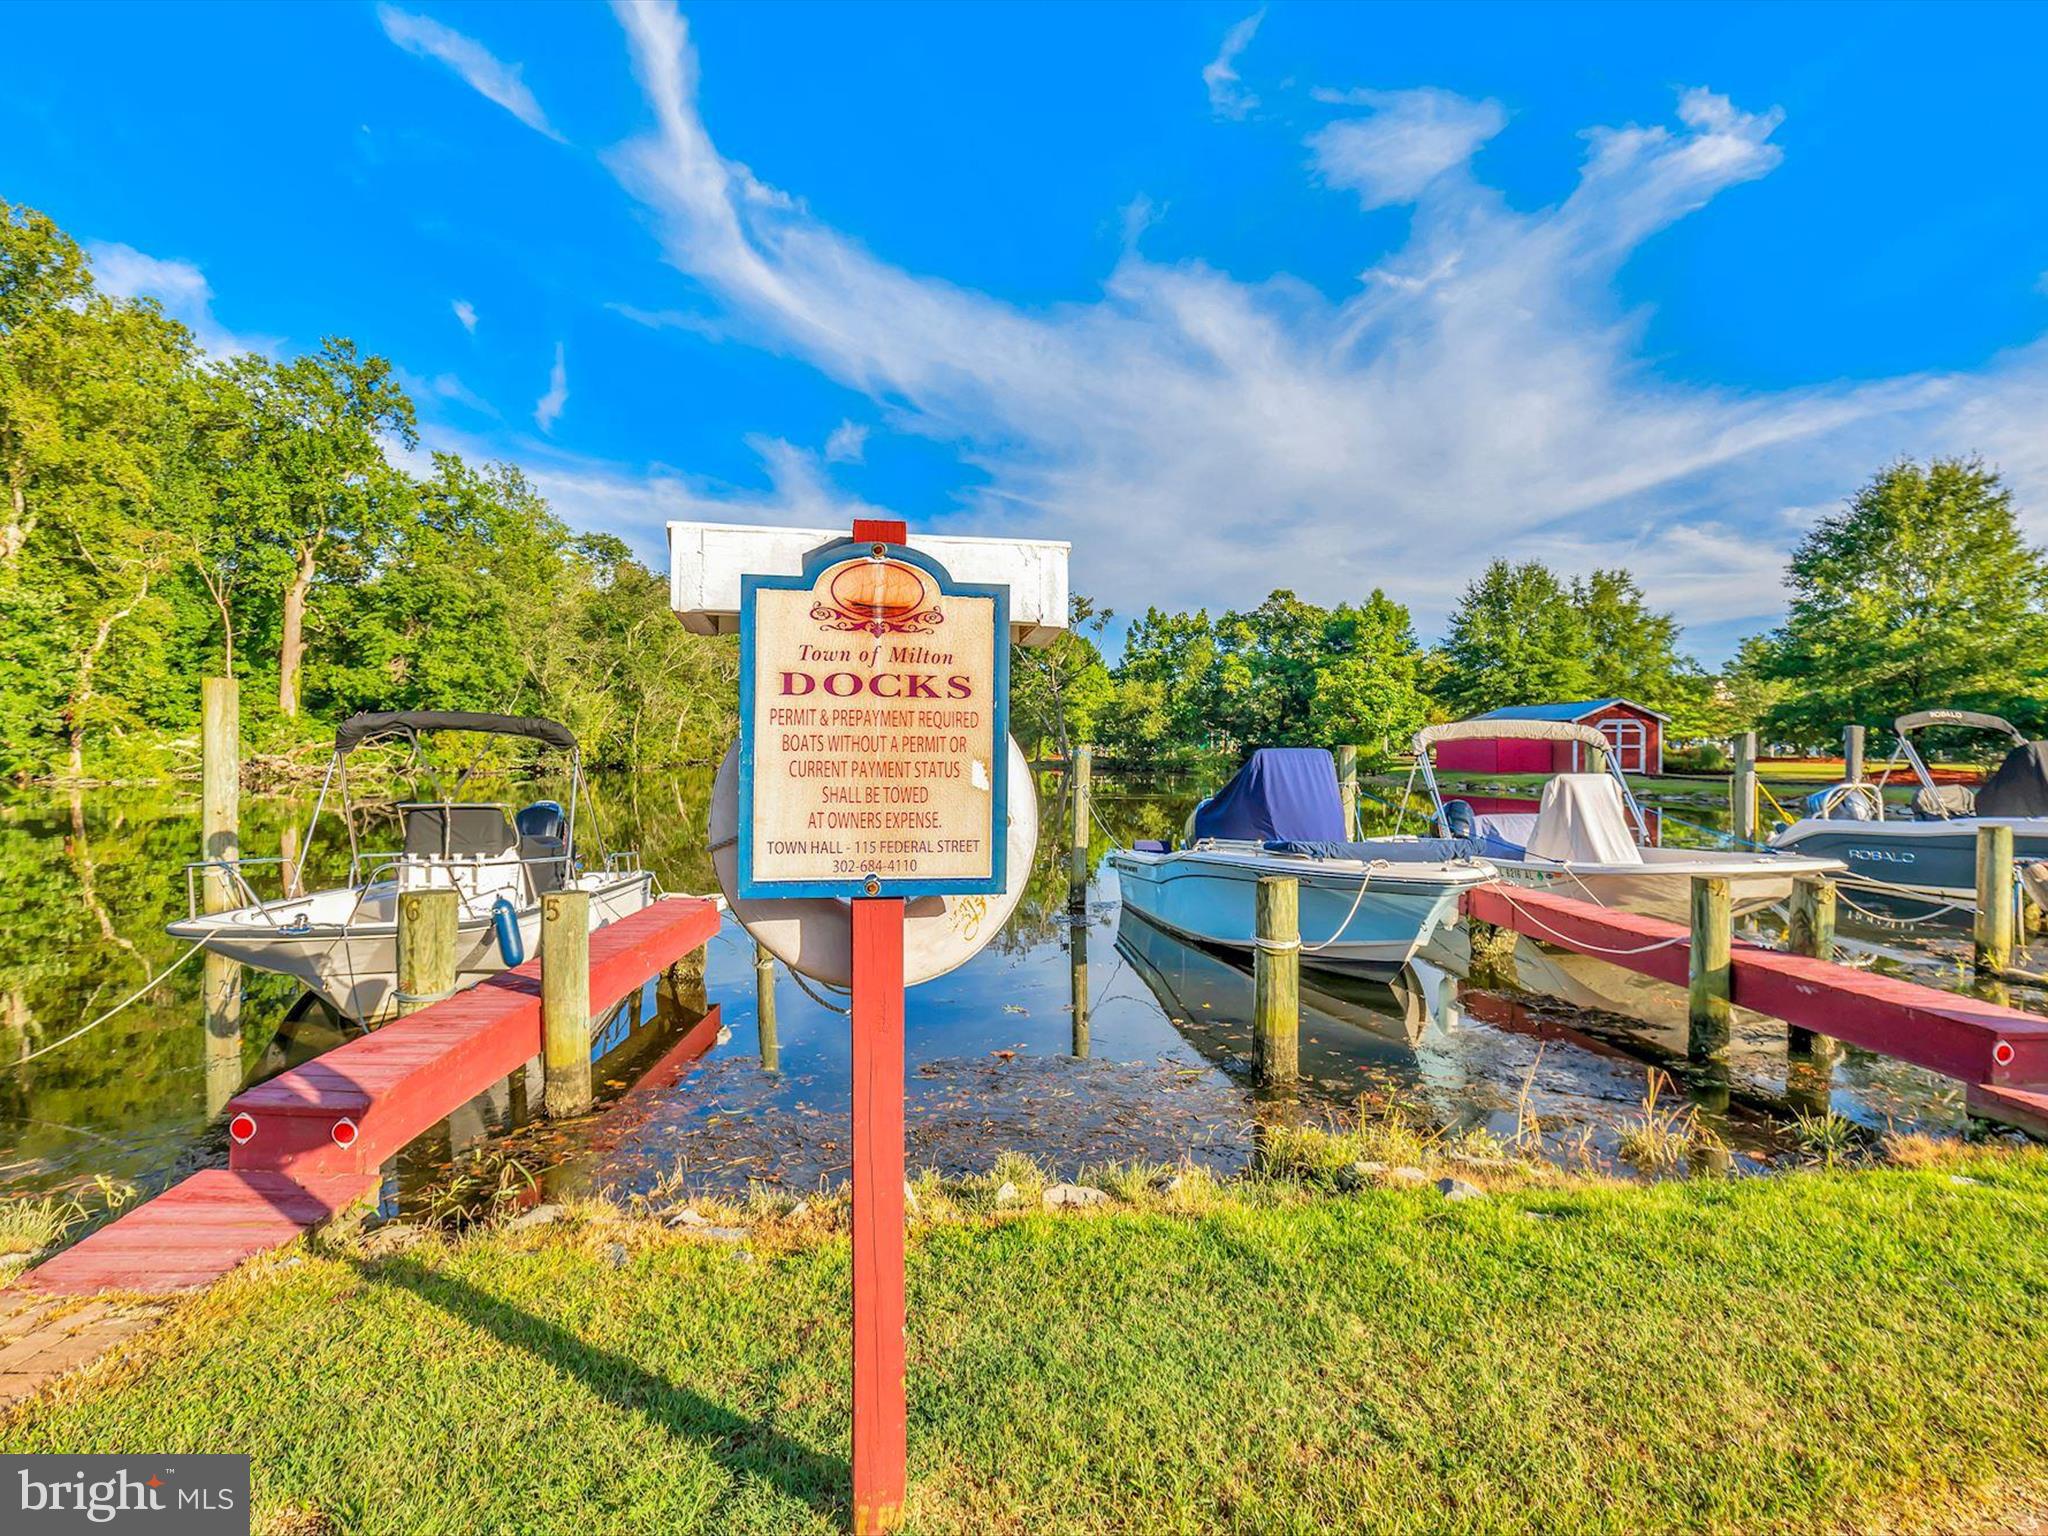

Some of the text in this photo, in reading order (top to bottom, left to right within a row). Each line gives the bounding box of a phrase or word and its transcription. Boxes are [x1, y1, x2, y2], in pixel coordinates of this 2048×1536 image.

[799, 644, 954, 669] Town of Milton
[778, 671, 972, 699] DOCKS
[769, 708, 979, 729] PERMIT & PREPAYMENT REQUIRED
[782, 734, 967, 753] BOATS WITHOUT A PERMIT OR
[789, 760, 960, 778] CURRENT PAYMENT STATUS
[821, 786, 929, 804] SHALL BE TOWED
[808, 811, 942, 829] AT OWNERS EXPENSE.
[766, 841, 807, 855] TOWN
[810, 841, 843, 855] HALL
[855, 840, 877, 854] 115
[880, 840, 934, 854] FEDERAL
[937, 839, 980, 853] STREET
[1848, 849, 1915, 863] ROBALO
[832, 860, 918, 873] 302-684-4110
[405, 899, 421, 922] 6
[546, 898, 561, 922] 5
